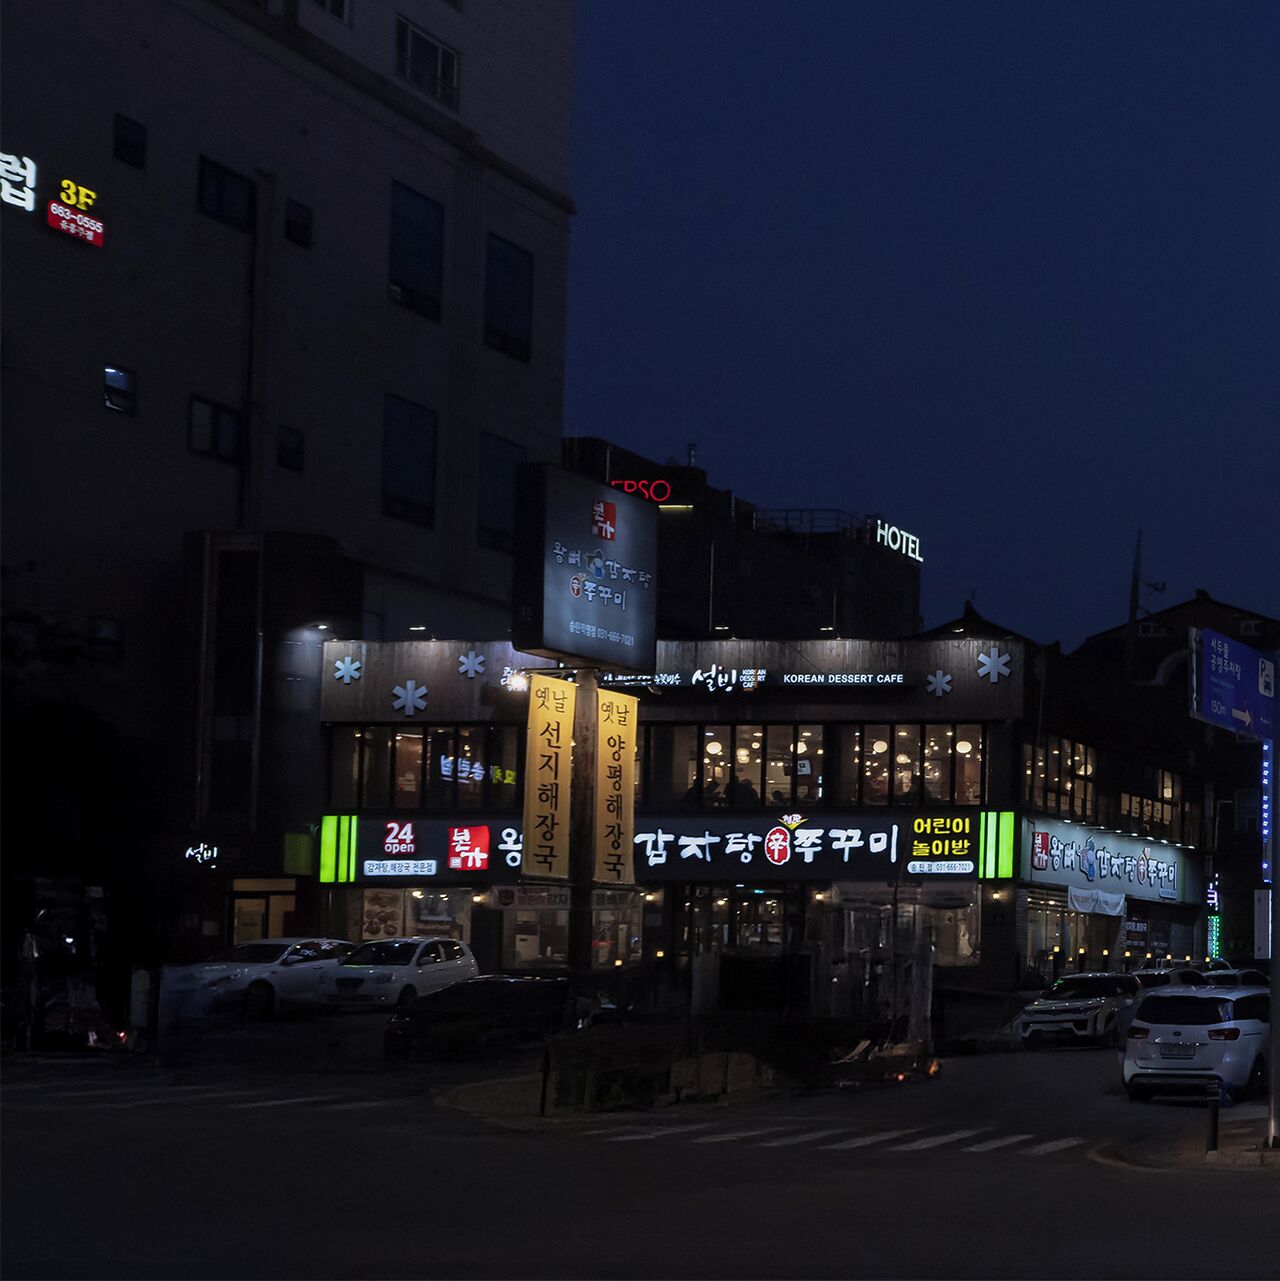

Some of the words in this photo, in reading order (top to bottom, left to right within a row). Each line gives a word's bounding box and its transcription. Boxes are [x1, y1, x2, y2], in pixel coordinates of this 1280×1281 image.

[59, 178, 97, 211] 3F
[50, 202, 104, 233] 663-0555
[877, 519, 924, 563] HOTEL
[604, 559, 652, 588] 감자탕
[783, 674, 825, 684] KOREAN
[828, 674, 874, 684] DESSERT
[876, 674, 904, 684] CAFE
[534, 686, 568, 713] 옛날
[600, 701, 630, 727] 옛날
[533, 720, 562, 873] 선지해장국
[602, 734, 626, 879] 양평해장국
[384, 822, 415, 844] 24
[912, 816, 971, 835] 어린이
[383, 843, 416, 854] open
[634, 827, 764, 868] 감자탕
[793, 824, 899, 864] 쭈꾸미
[911, 837, 971, 857] 놀이방
[1096, 847, 1138, 882] 감자탕
